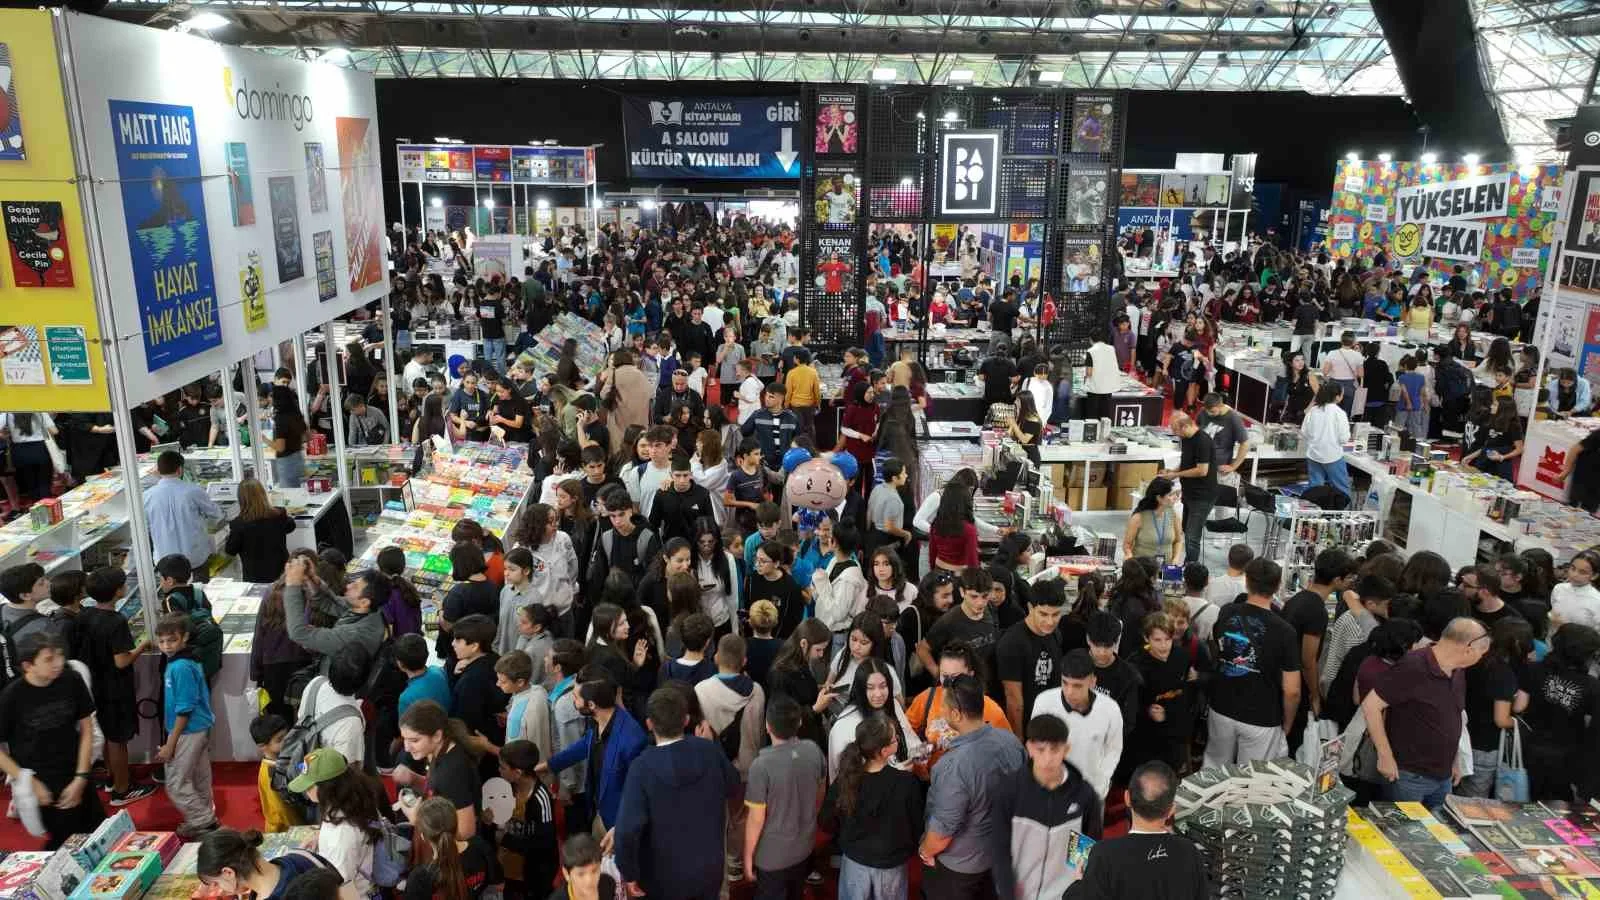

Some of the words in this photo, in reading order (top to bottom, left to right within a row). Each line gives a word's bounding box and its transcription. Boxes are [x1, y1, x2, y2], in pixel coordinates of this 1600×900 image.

[236, 78, 312, 131] domingo
[694, 102, 732, 111] ANTALYA
[767, 101, 800, 122] GİRİ
[685, 110, 712, 121] KİTAP
[714, 112, 741, 121] FUARI
[119, 112, 157, 145] MATT
[161, 115, 192, 146] HAIG
[662, 132, 671, 145] A
[676, 132, 729, 146] SALONU
[631, 148, 683, 166] KÜLTÜR
[688, 153, 760, 167] YAYINLARI
[1400, 182, 1506, 222] YÜKSELEN
[7, 205, 40, 215] Gezgin
[1130, 215, 1170, 224] ANTALYA
[818, 238, 852, 247] KENAN
[1426, 224, 1478, 257] ZEKA
[19, 251, 47, 259] Cecile
[820, 246, 850, 254] YILDIZ
[34, 260, 49, 268] Pin
[153, 262, 198, 302] HAYAT
[146, 297, 215, 346] İMKÂNSIZ
